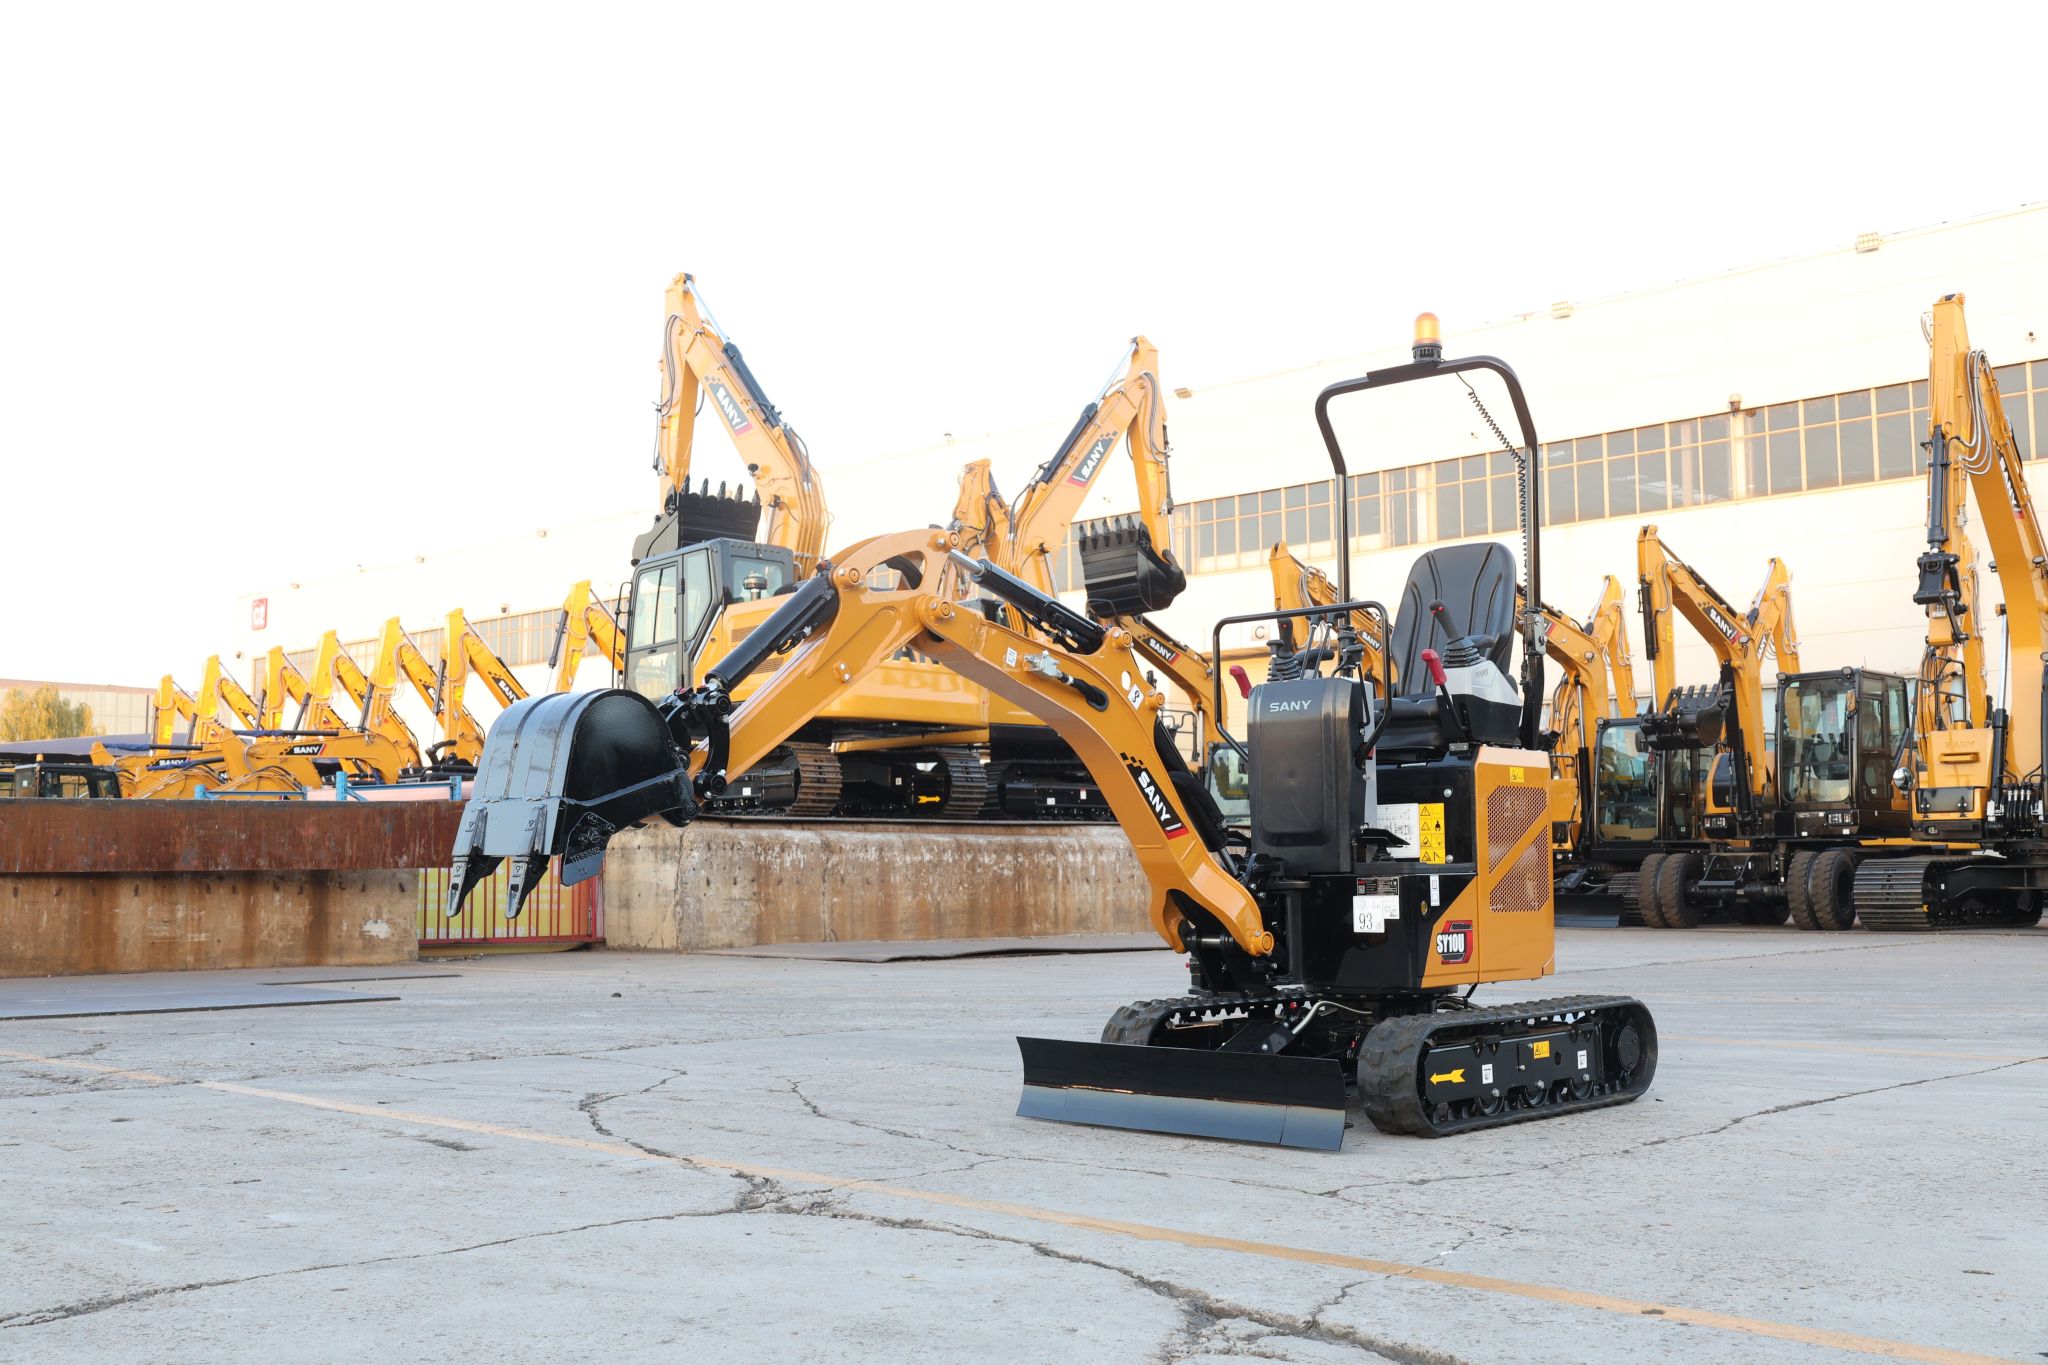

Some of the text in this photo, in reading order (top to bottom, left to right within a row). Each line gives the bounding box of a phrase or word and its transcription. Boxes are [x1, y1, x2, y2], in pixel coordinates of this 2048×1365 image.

[716, 386, 741, 426] SANY
[1081, 440, 1104, 479] SANY
[1254, 625, 1266, 640] C
[1709, 610, 1733, 639] SANY
[1149, 638, 1172, 660] SANY
[1361, 631, 1381, 649] SANY
[1269, 699, 1313, 713] SANY
[293, 745, 320, 755] SANY
[1138, 770, 1172, 823] SANY
[1359, 912, 1373, 930] 93
[1436, 933, 1465, 954] SY10U
